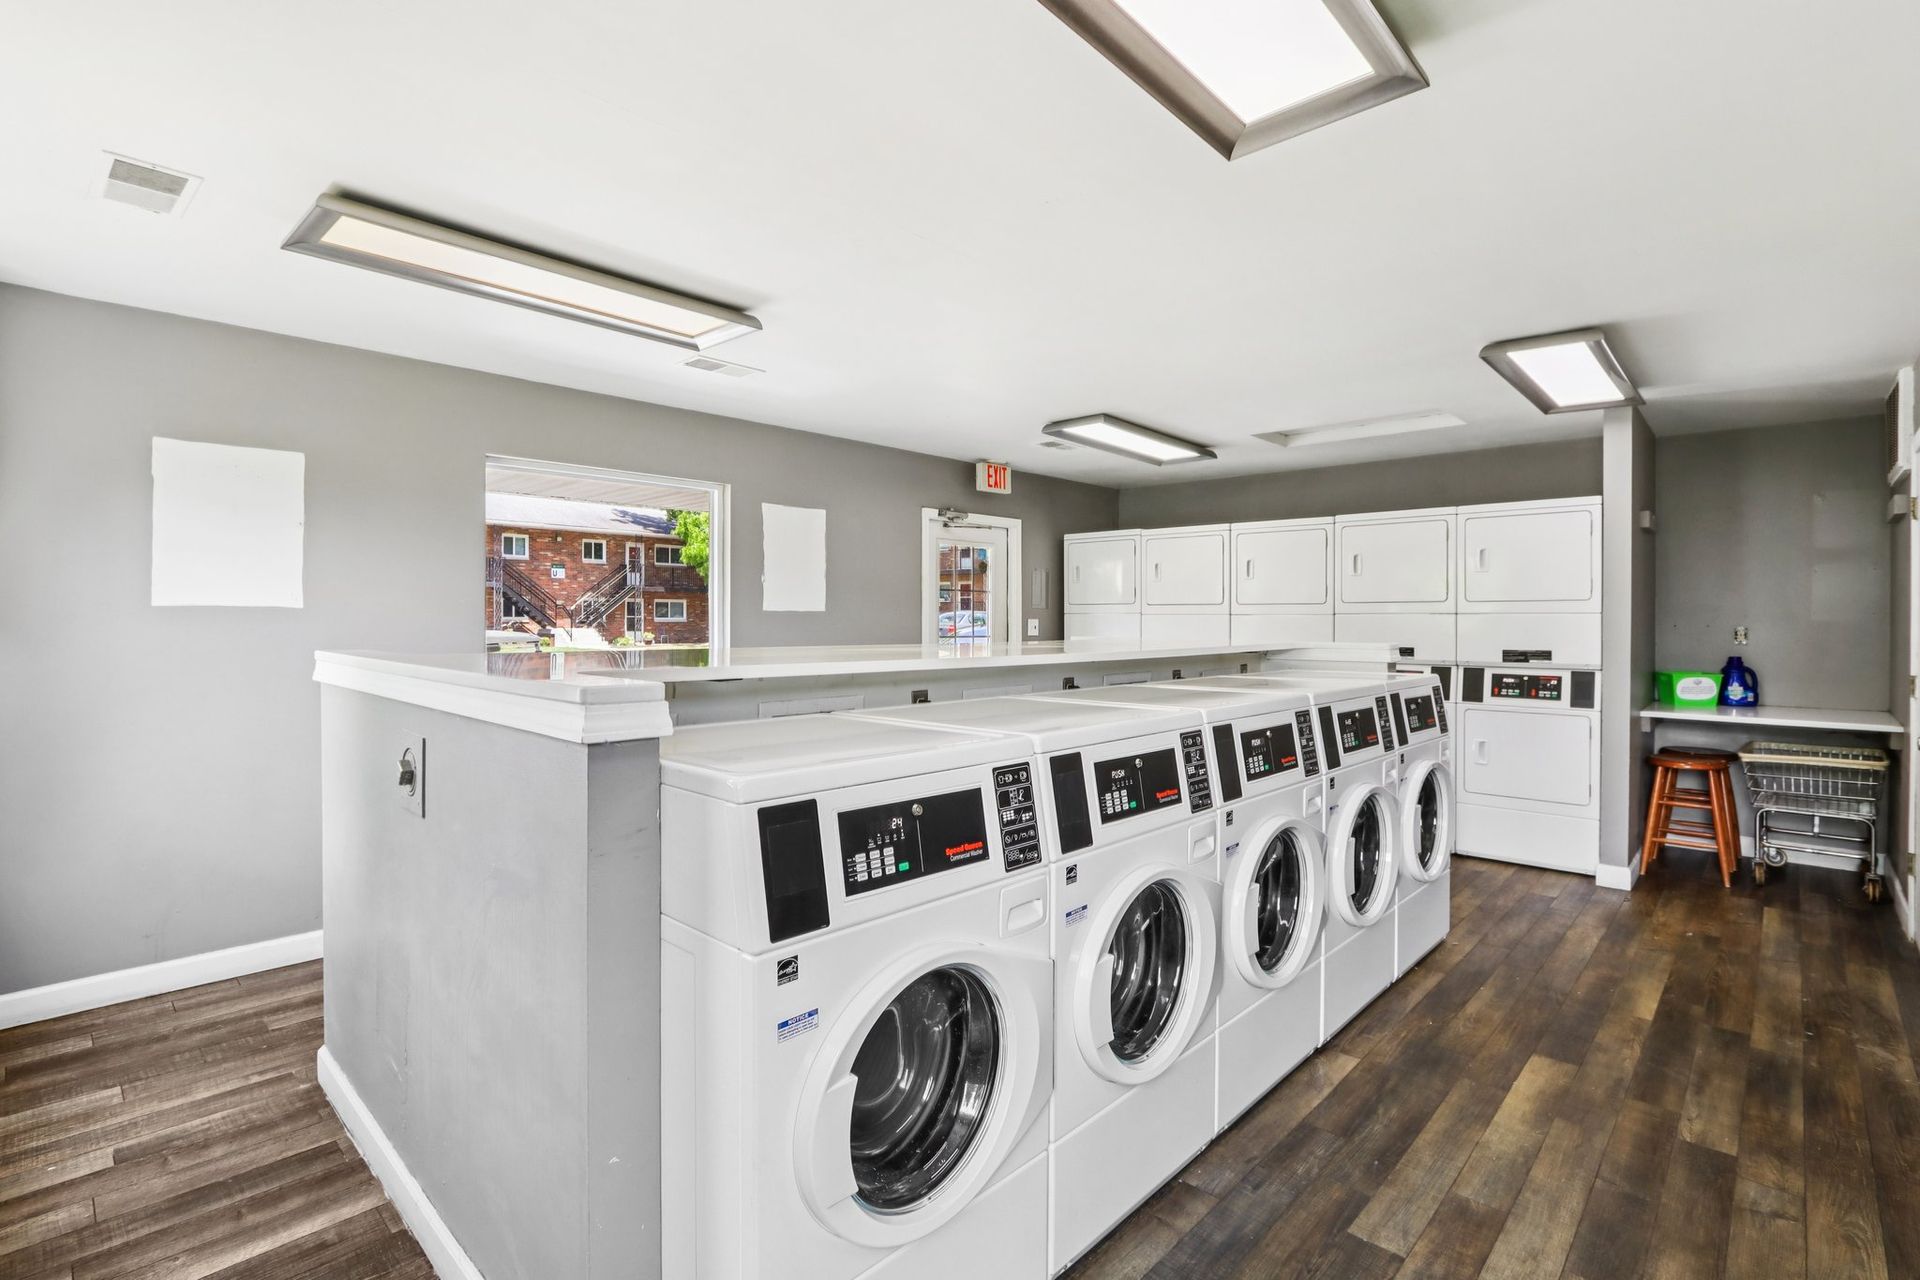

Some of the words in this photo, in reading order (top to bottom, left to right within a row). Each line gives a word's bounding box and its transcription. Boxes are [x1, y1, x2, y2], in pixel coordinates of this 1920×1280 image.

[987, 464, 1007, 490] EXIT
[1111, 769, 1125, 779] PUSH
[891, 817, 903, 829] 24
